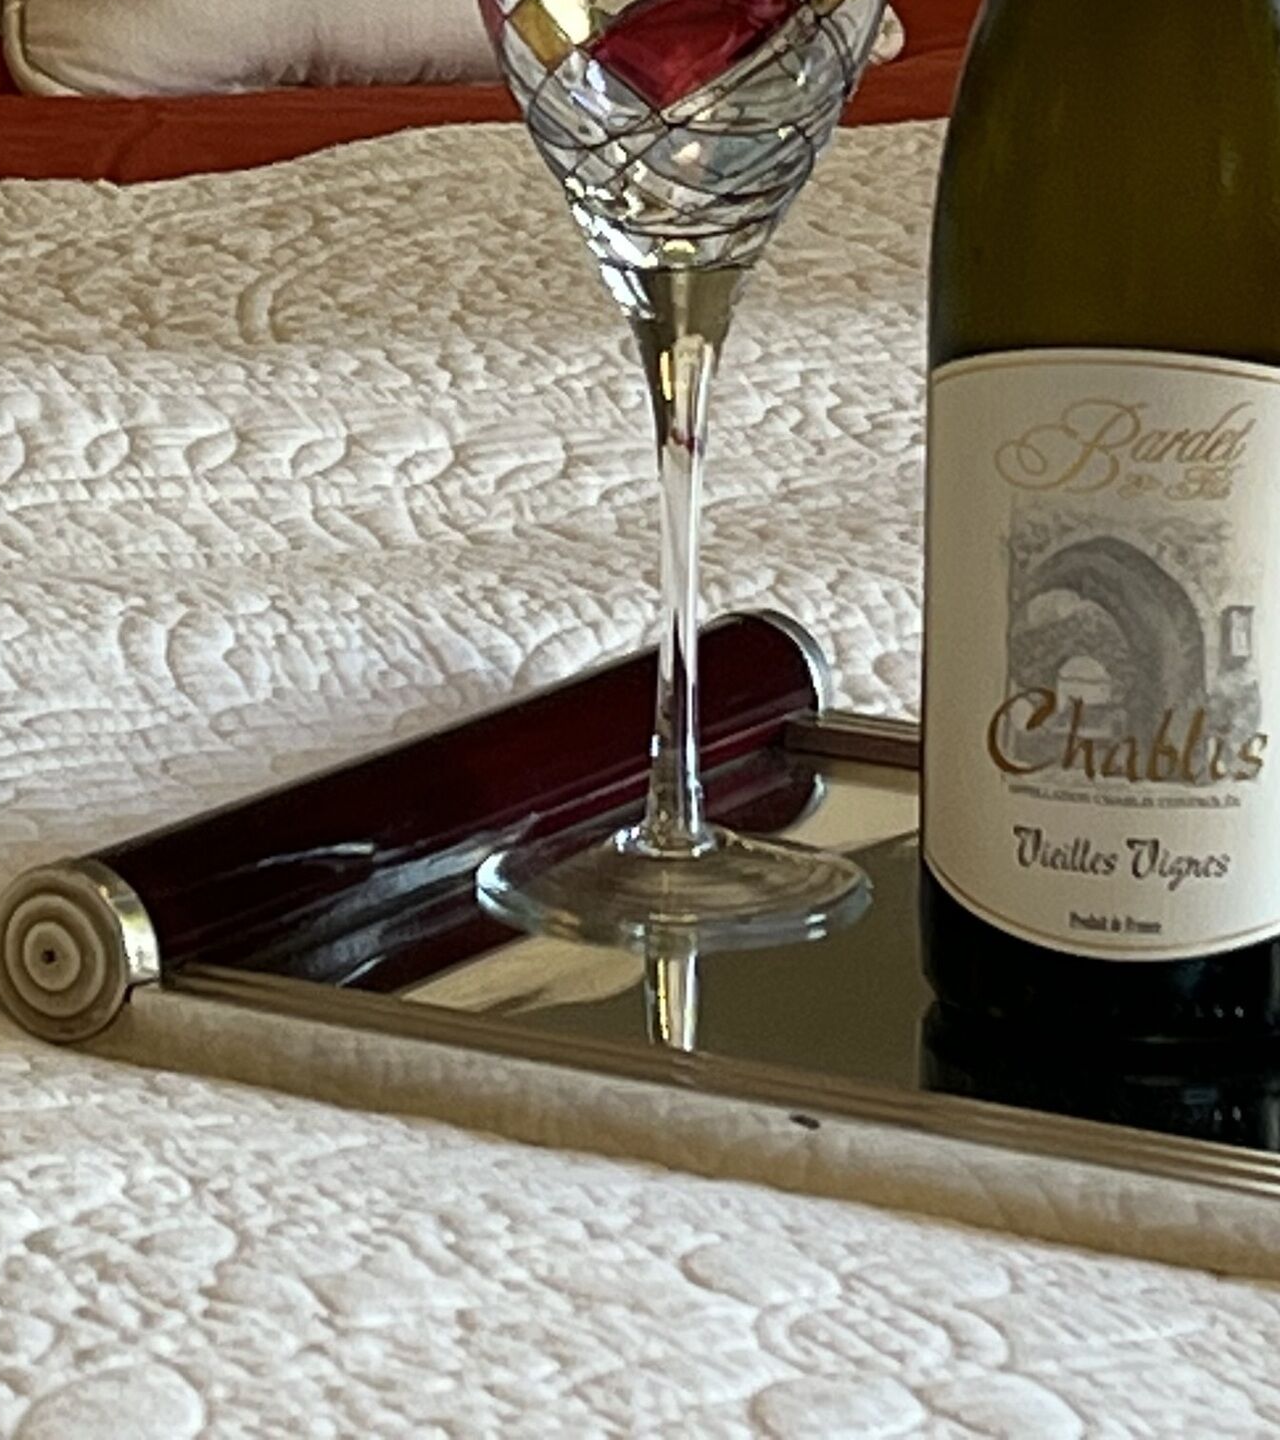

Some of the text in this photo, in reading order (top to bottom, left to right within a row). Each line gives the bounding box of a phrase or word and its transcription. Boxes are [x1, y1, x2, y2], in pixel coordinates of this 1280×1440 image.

[987, 687, 1268, 784] Chablis
[1013, 824, 1231, 892] Vieilles Vignes
